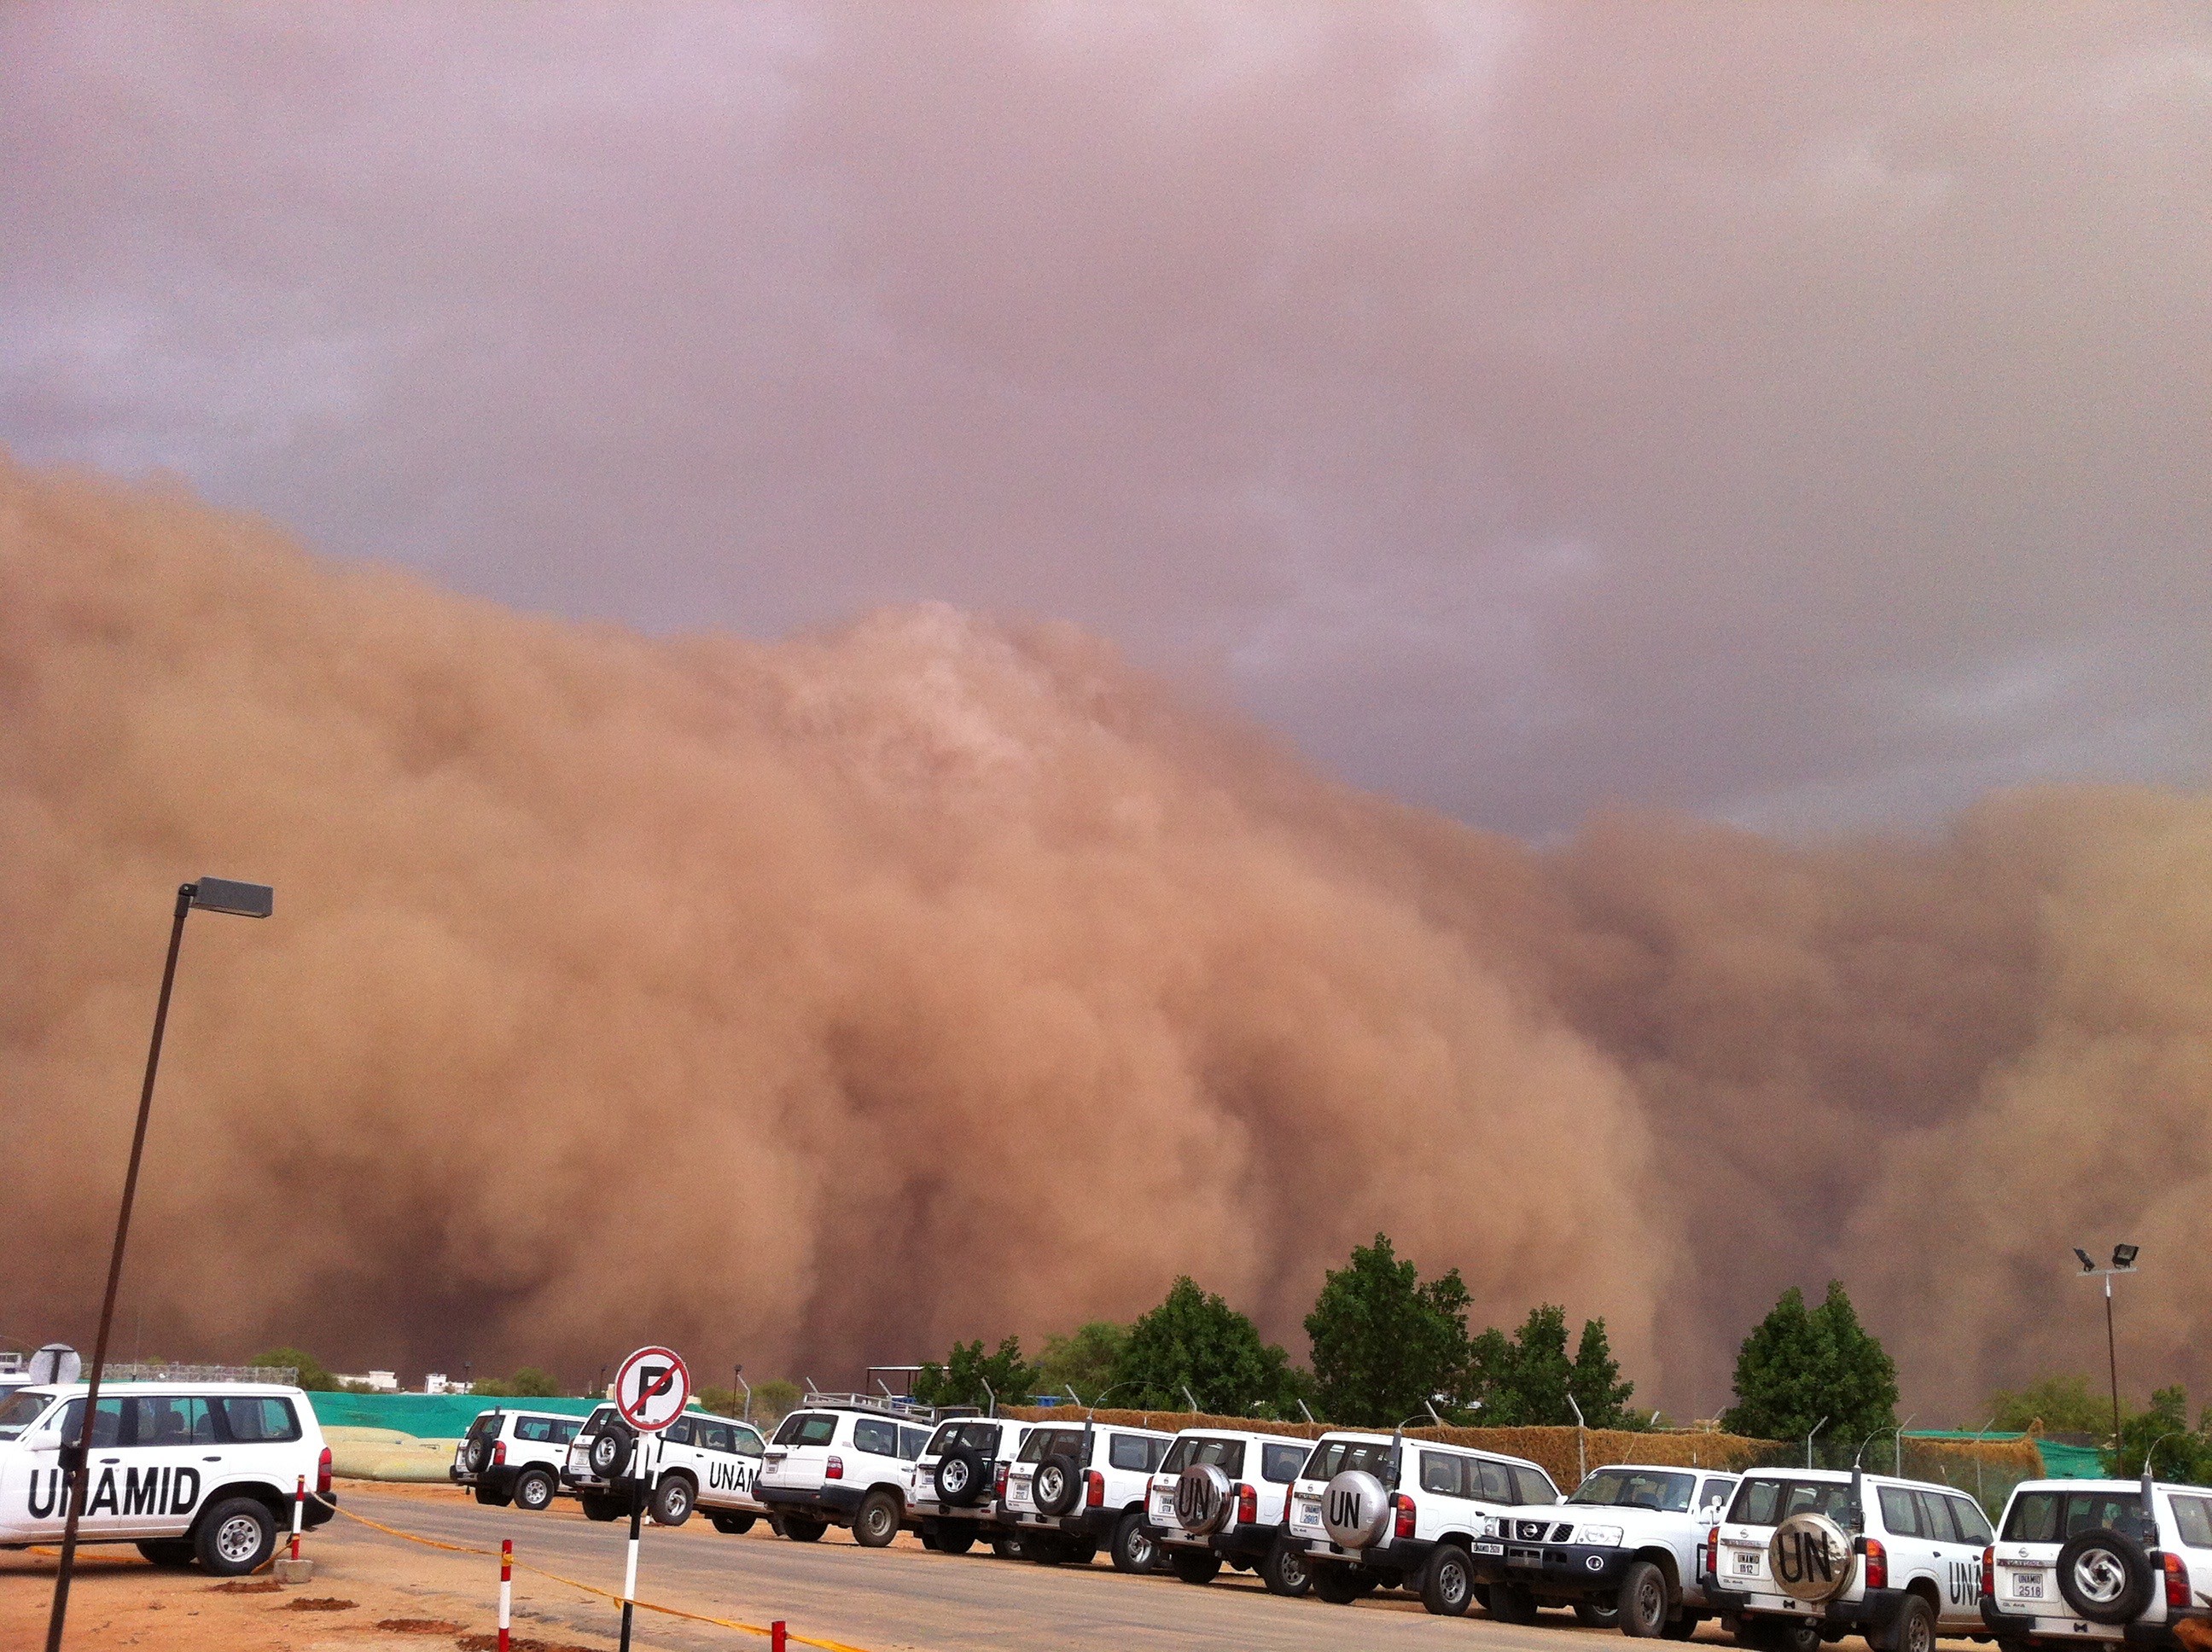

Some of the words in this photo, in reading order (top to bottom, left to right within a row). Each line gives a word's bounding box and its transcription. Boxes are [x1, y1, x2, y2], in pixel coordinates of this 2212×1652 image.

[637, 1366, 673, 1416] P
[1179, 1476, 1212, 1520] UN
[1330, 1490, 1361, 1529] UN
[1778, 1532, 1832, 1583] UN
[2018, 1585, 2041, 1597] 2518
